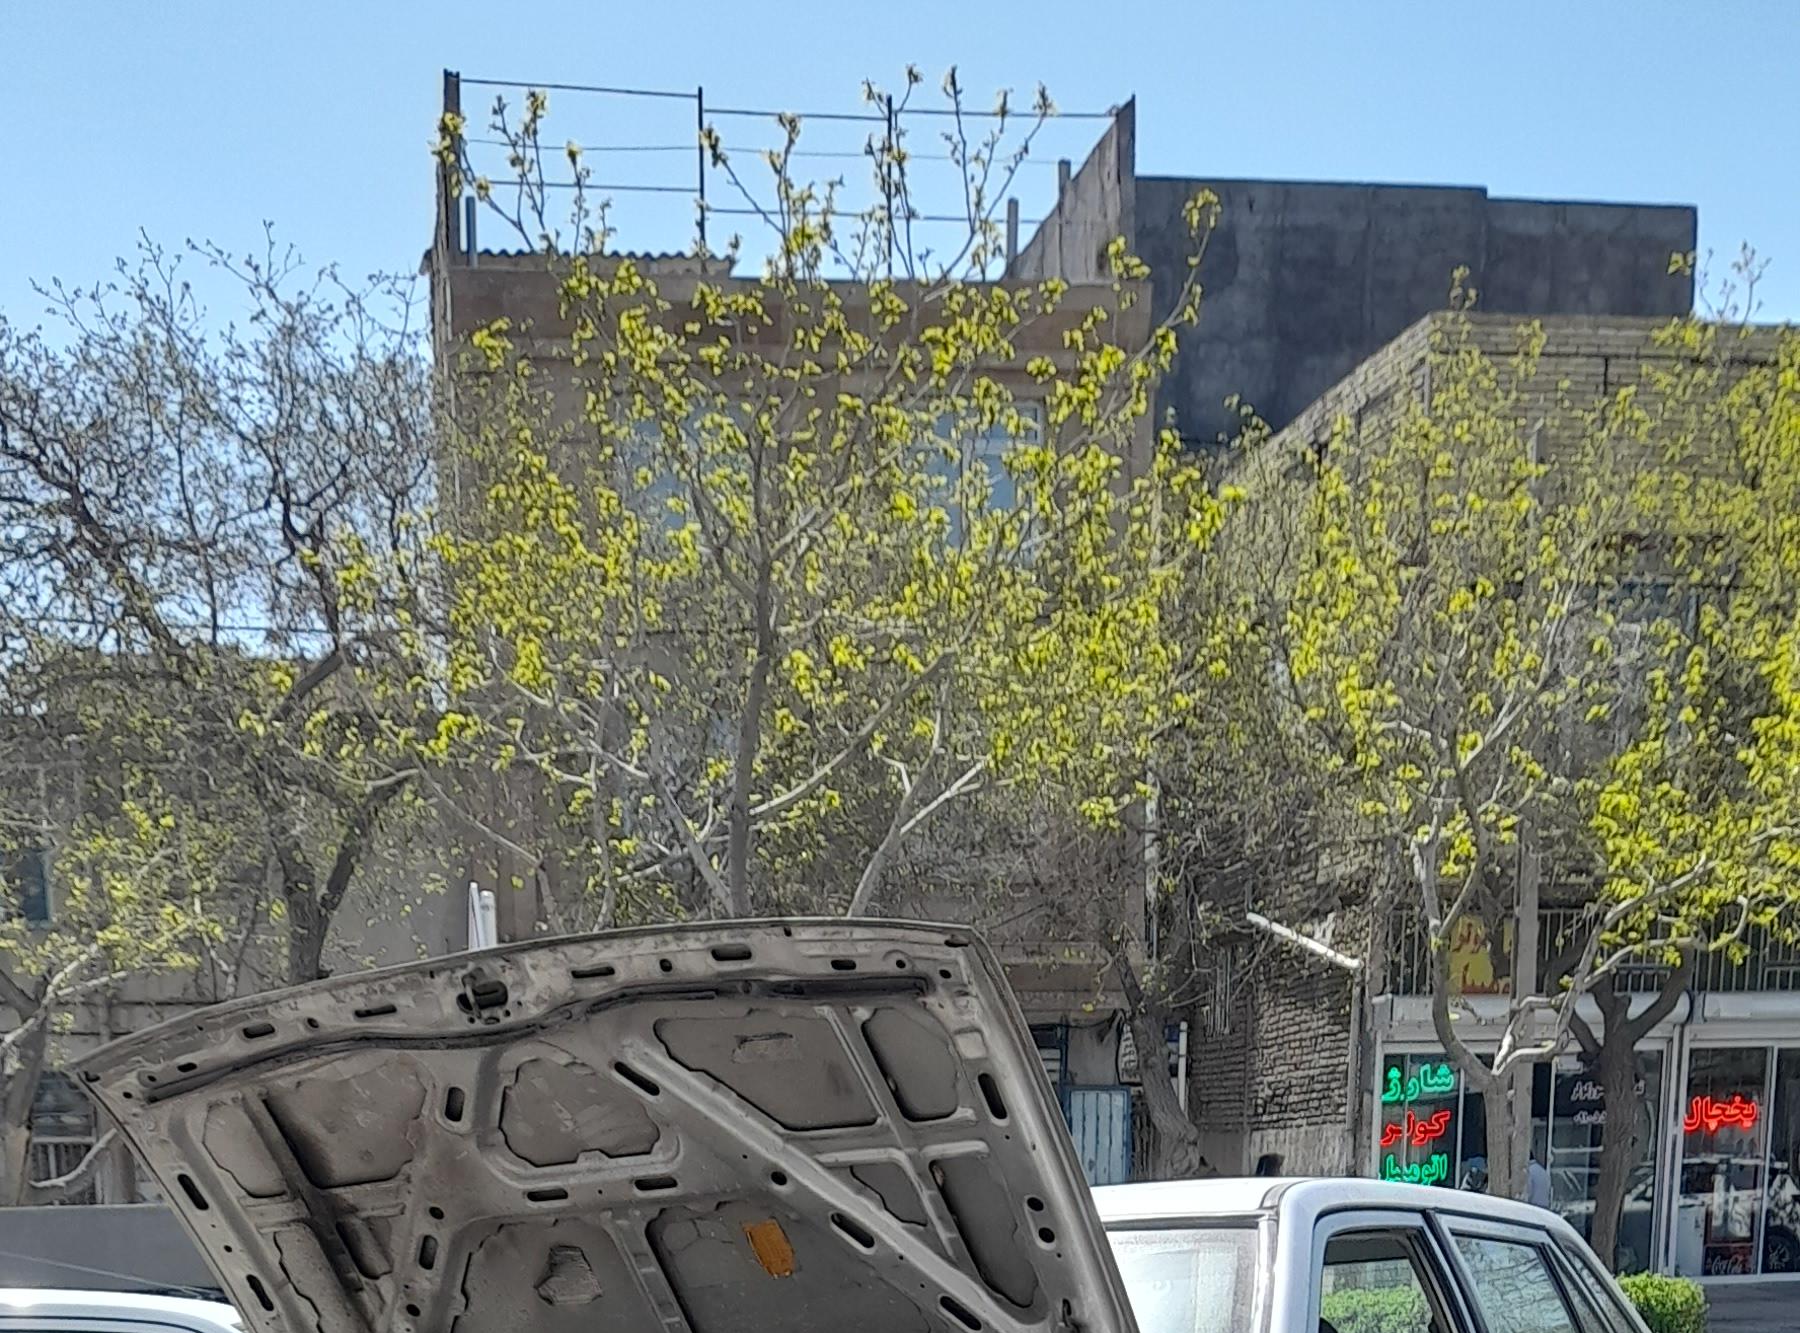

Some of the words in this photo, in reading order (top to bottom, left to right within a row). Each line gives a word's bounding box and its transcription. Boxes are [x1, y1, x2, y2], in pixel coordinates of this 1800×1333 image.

[1382, 1063, 1455, 1102] شارژ
[1380, 1110, 1452, 1146] کولر
[1684, 1094, 1758, 1131] یخچال
